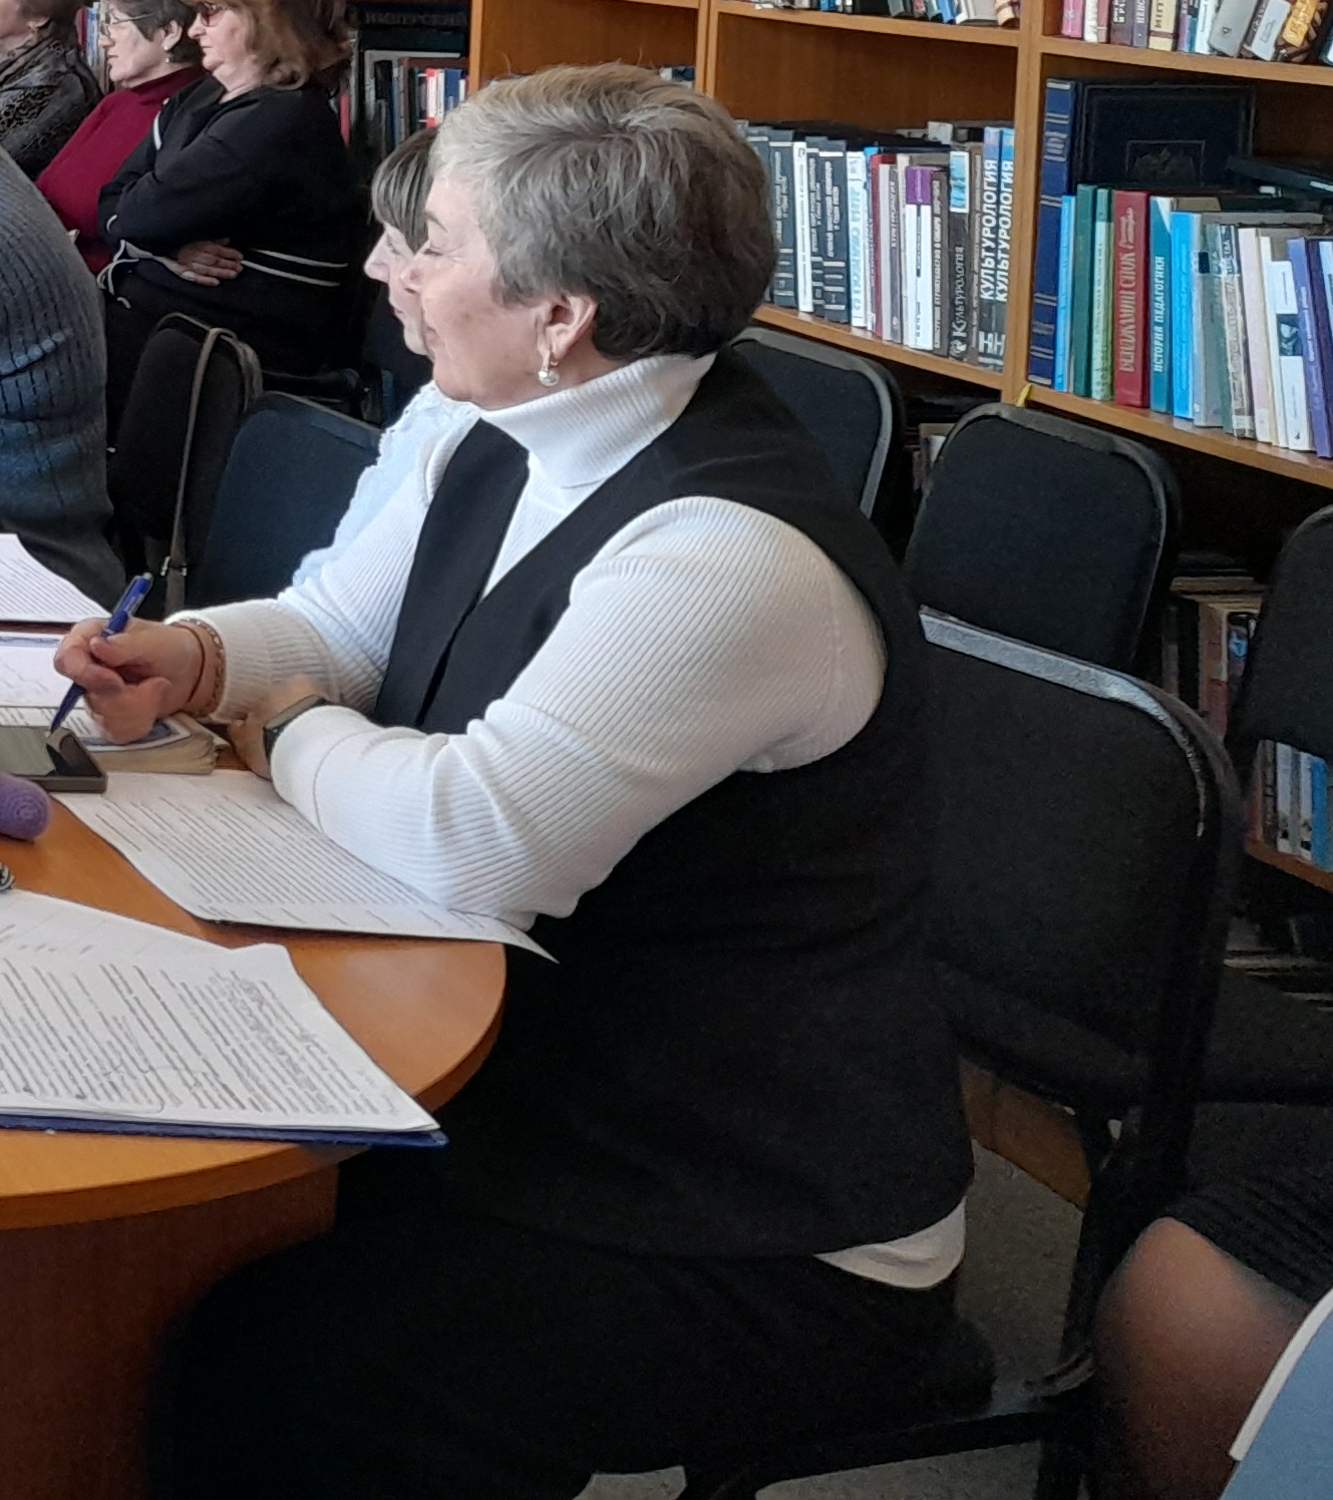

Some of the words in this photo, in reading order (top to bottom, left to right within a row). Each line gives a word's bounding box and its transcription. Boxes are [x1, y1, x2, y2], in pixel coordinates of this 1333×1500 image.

[979, 159, 997, 301] КУЛЬТУРОЛОГИЯ
[996, 160, 1014, 303] КУЛЬТУРОЛОГИЯ
[1154, 256, 1165, 323] ПЕДАГОГИКИ
[1153, 326, 1164, 372] ИСТОРИЯ
